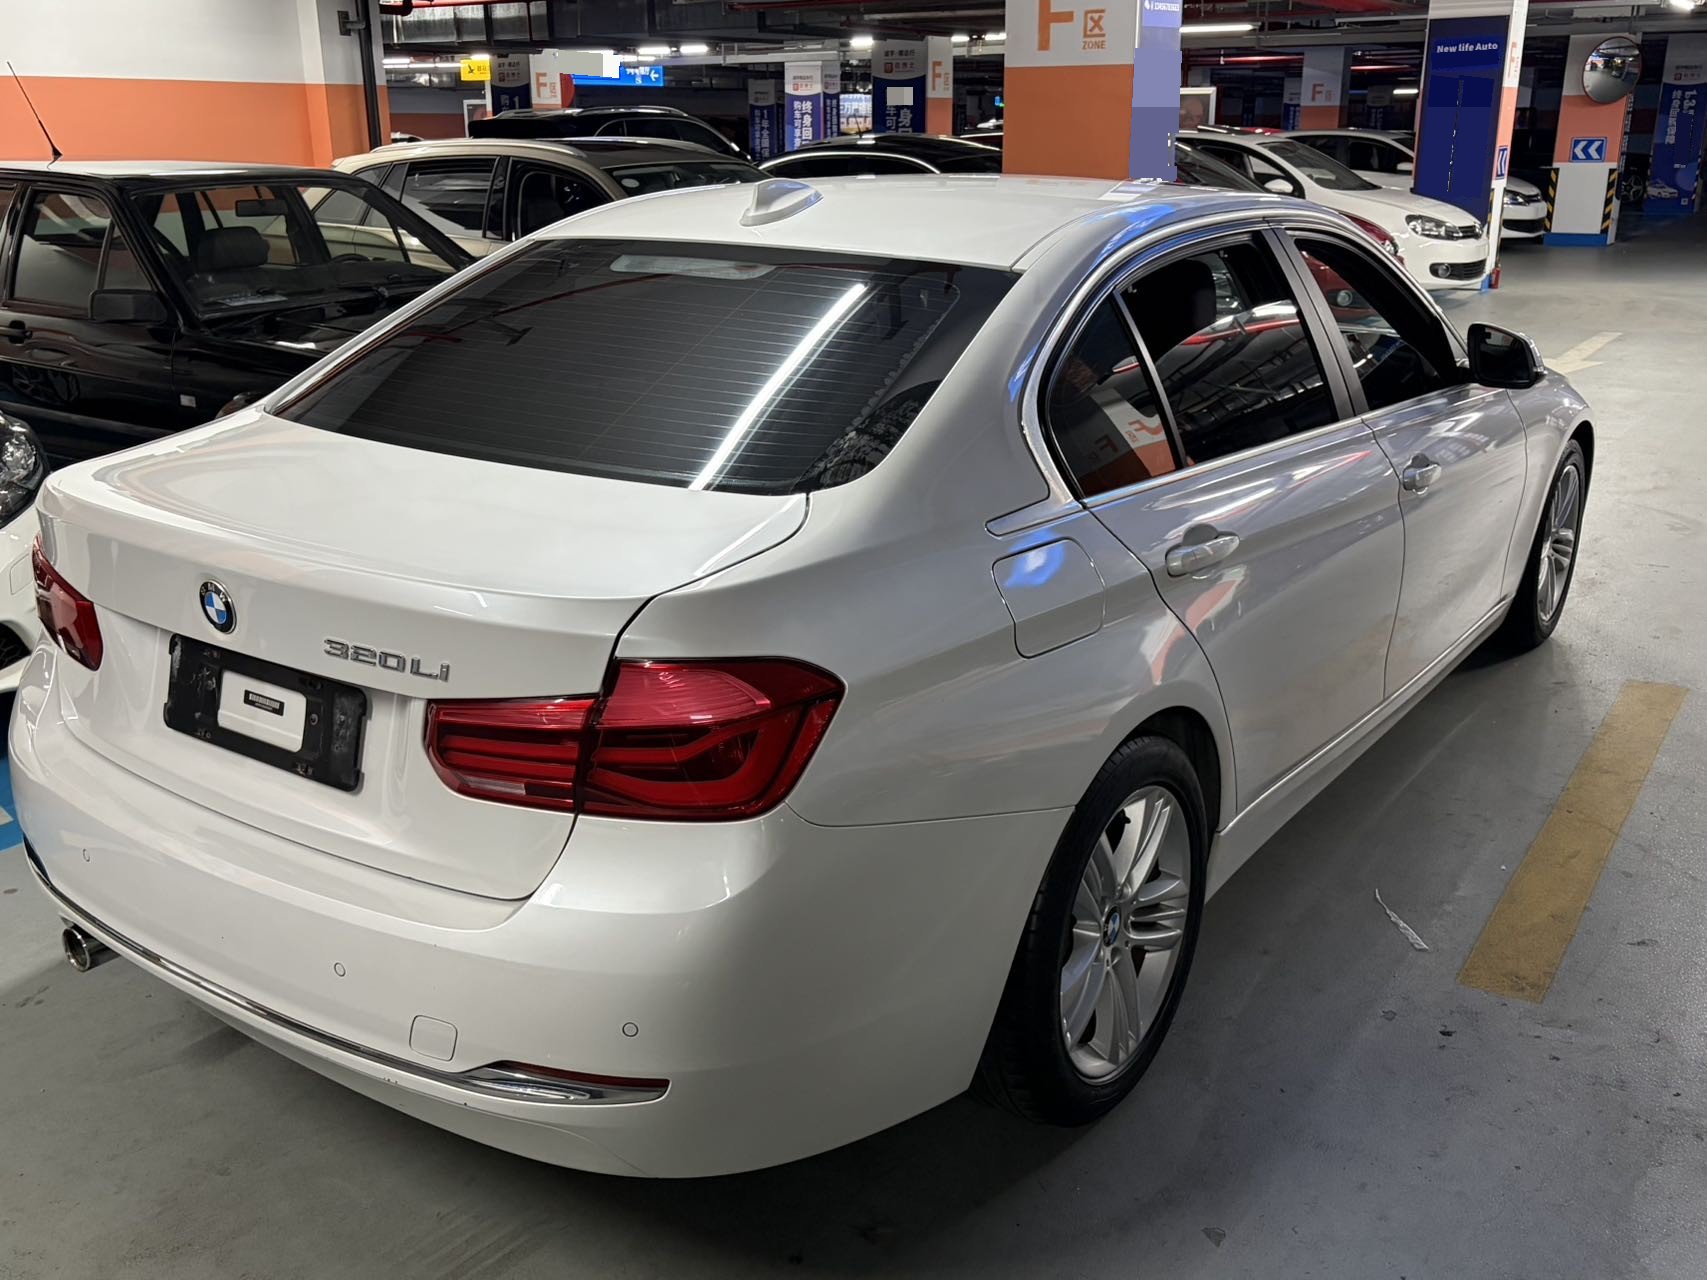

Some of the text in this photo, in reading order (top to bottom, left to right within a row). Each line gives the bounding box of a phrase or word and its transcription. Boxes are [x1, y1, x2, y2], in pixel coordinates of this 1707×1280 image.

[1037, 0, 1106, 51] F 区
[1082, 41, 1106, 50] ZONE
[1436, 43, 1498, 53] New life Auto
[535, 72, 547, 98] F
[932, 61, 944, 91] F
[1311, 83, 1324, 101] F
[801, 100, 813, 145] 终身回
[323, 639, 450, 682] 320Li
